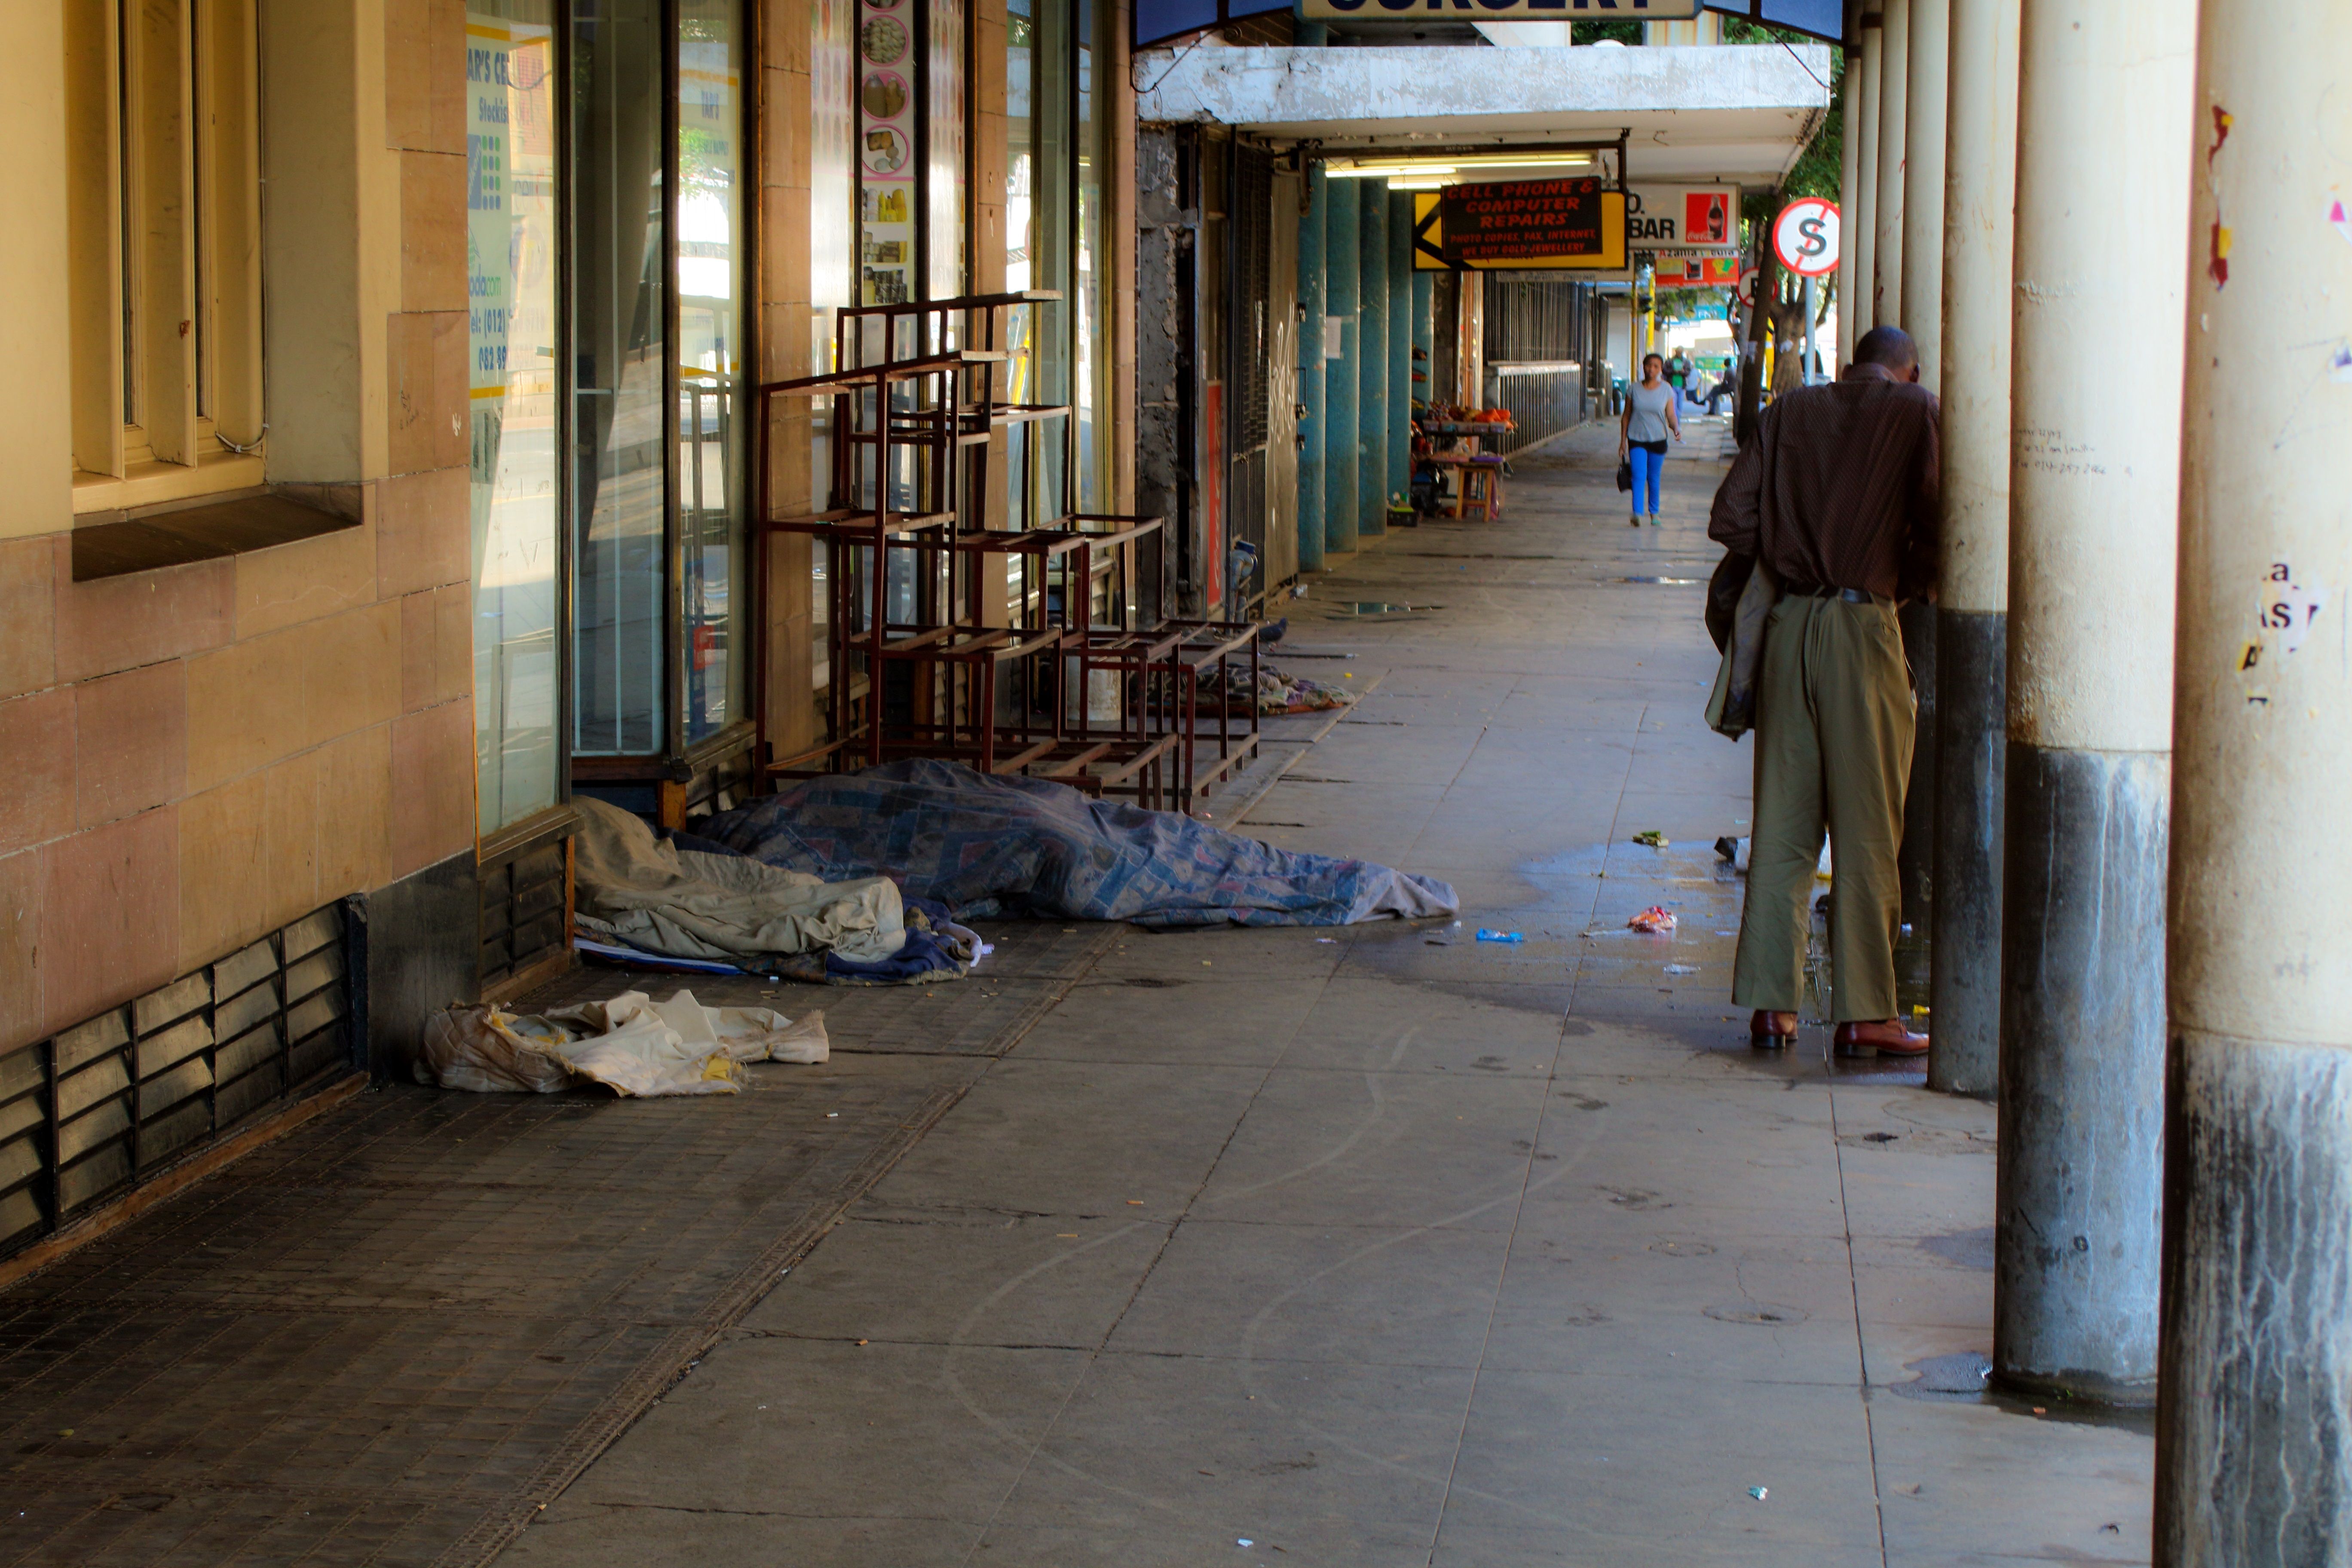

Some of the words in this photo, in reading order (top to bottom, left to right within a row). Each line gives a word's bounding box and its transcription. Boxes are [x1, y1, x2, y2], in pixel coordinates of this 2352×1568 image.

[479, 96, 509, 124] Stockis
[1447, 185, 1493, 199] CELL
[1502, 182, 1573, 196] PHONE
[1580, 180, 1594, 194] &
[1466, 197, 1580, 213] COMPUTER
[1480, 212, 1568, 228] REPAIRS
[1629, 218, 1675, 239] BAR
[1450, 233, 1482, 243] PHOTO
[1795, 217, 1827, 256] S
[1462, 246, 1477, 256] WE
[1480, 245, 1499, 255] BUY
[1502, 244, 1527, 254] GOLD
[1530, 242, 1585, 253] JEWELLERY
[484, 307, 505, 339] (012)
